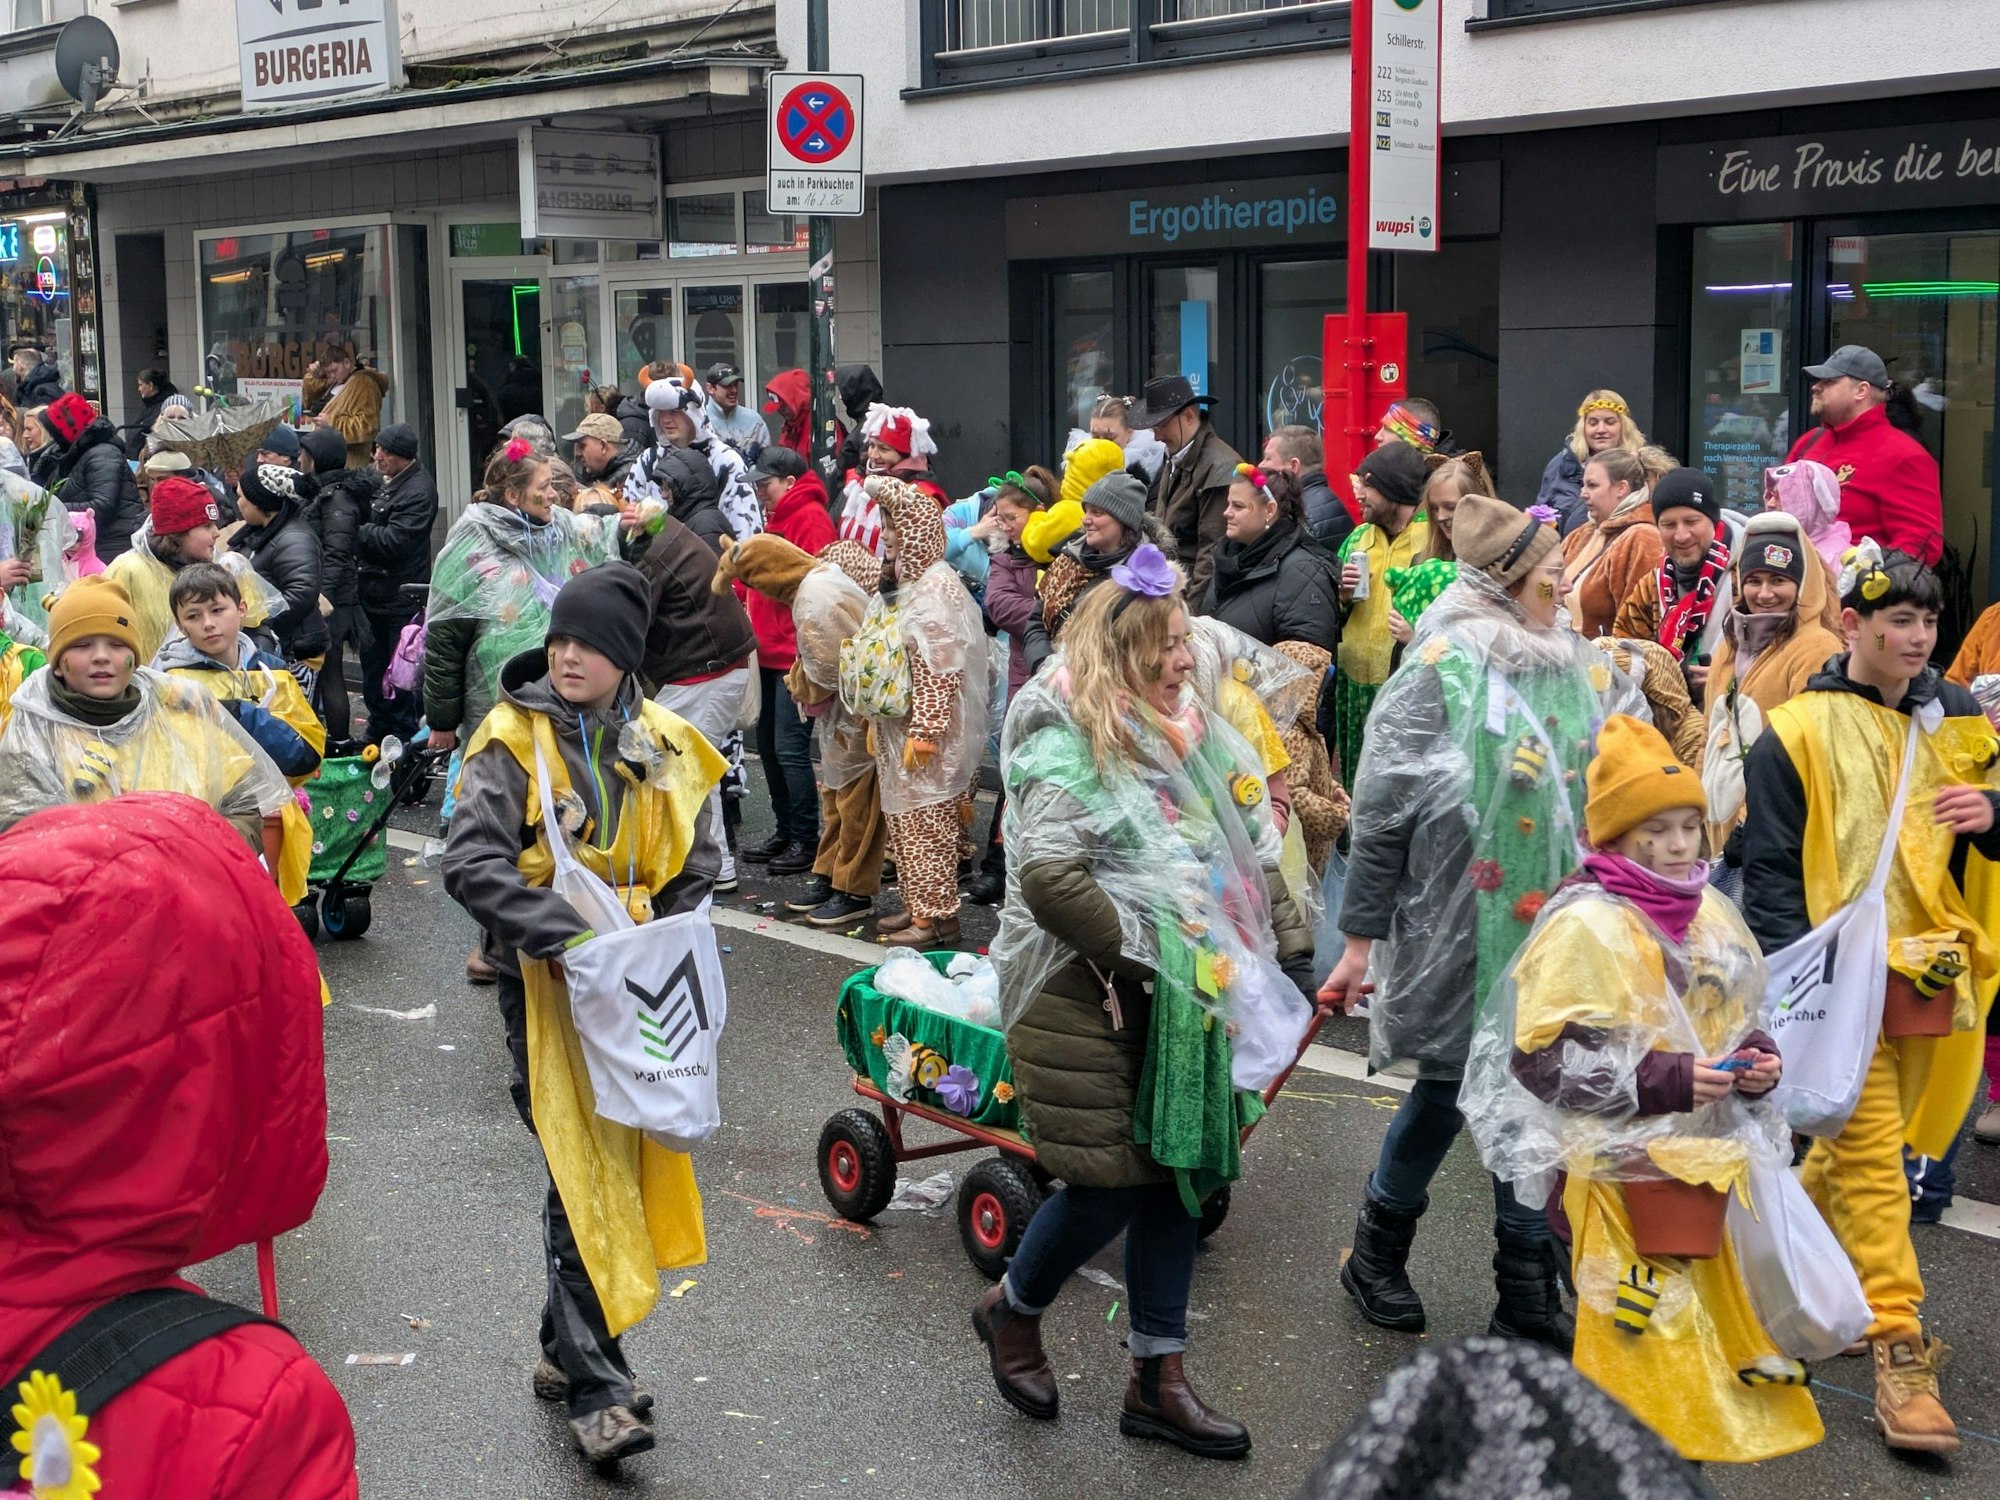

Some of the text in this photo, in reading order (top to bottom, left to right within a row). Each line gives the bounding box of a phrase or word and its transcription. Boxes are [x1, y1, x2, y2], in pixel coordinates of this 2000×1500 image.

[1387, 33, 1426, 50] Schillerstr.
[254, 37, 372, 87] BURGERIA
[1377, 65, 1391, 80] 222
[1377, 89, 1391, 103] 255
[1376, 113, 1390, 126] N21
[1376, 136, 1390, 149] N22
[1718, 150, 1781, 194] Eine
[1793, 142, 1885, 189] Praxis
[1894, 142, 1943, 183] die
[777, 177, 854, 190] auch in Parkbuchten
[787, 192, 844, 206] am: 16.2.26
[1129, 188, 1337, 241] Ergotherapie
[1376, 215, 1415, 237] wupsi
[1419, 219, 1429, 228] VRS
[1703, 441, 1760, 451] Therapiezeiten
[1703, 453, 1777, 464] nach Vereinbarung:
[1703, 465, 1717, 474] Mo:
